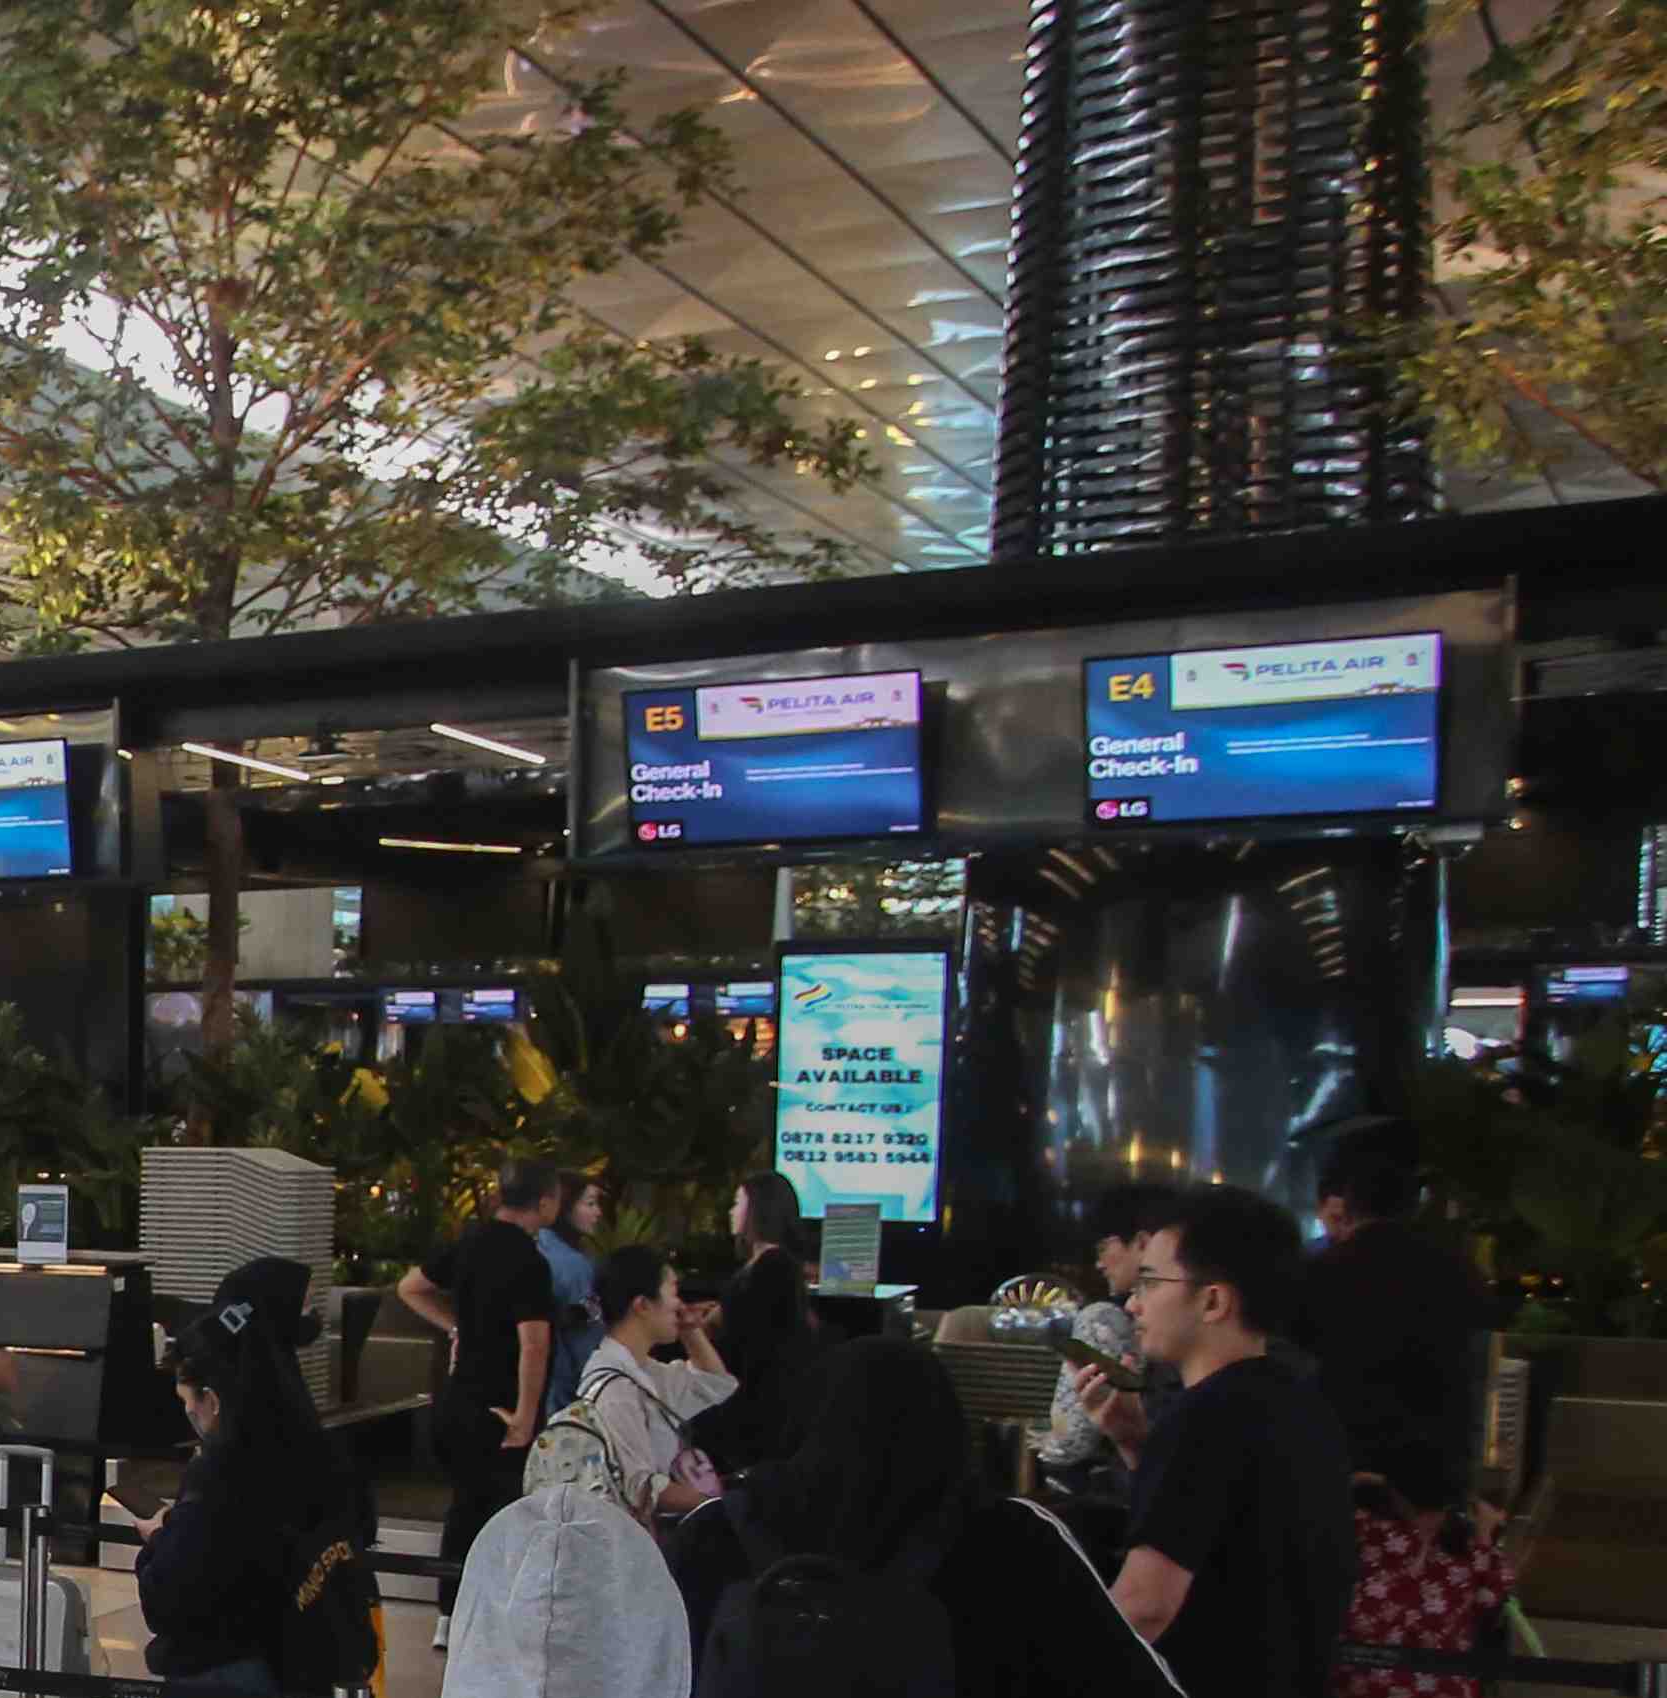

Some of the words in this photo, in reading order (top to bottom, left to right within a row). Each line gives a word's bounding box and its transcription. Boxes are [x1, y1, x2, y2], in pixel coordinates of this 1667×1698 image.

[1255, 657, 1339, 678] PELITA
[1342, 655, 1385, 670] AIR
[1108, 673, 1155, 701] E4
[768, 694, 836, 710] PELITA
[841, 691, 875, 704] AIR
[644, 706, 684, 732] E5
[1089, 732, 1186, 756] General
[10, 756, 34, 766] AIR
[1088, 756, 1199, 779] Check-In
[630, 760, 711, 782] General
[630, 781, 723, 803] Check-In
[1119, 801, 1148, 817] LG
[657, 824, 681, 839] LG
[821, 1047, 893, 1062] SPACE
[796, 1069, 924, 1084] AVAILABLE
[805, 1102, 877, 1114] CONTACT
[880, 1103, 904, 1114] US
[781, 1131, 824, 1145] 0878
[831, 1131, 876, 1145] 8217
[883, 1132, 928, 1146] 9320
[784, 1150, 827, 1163] 0812
